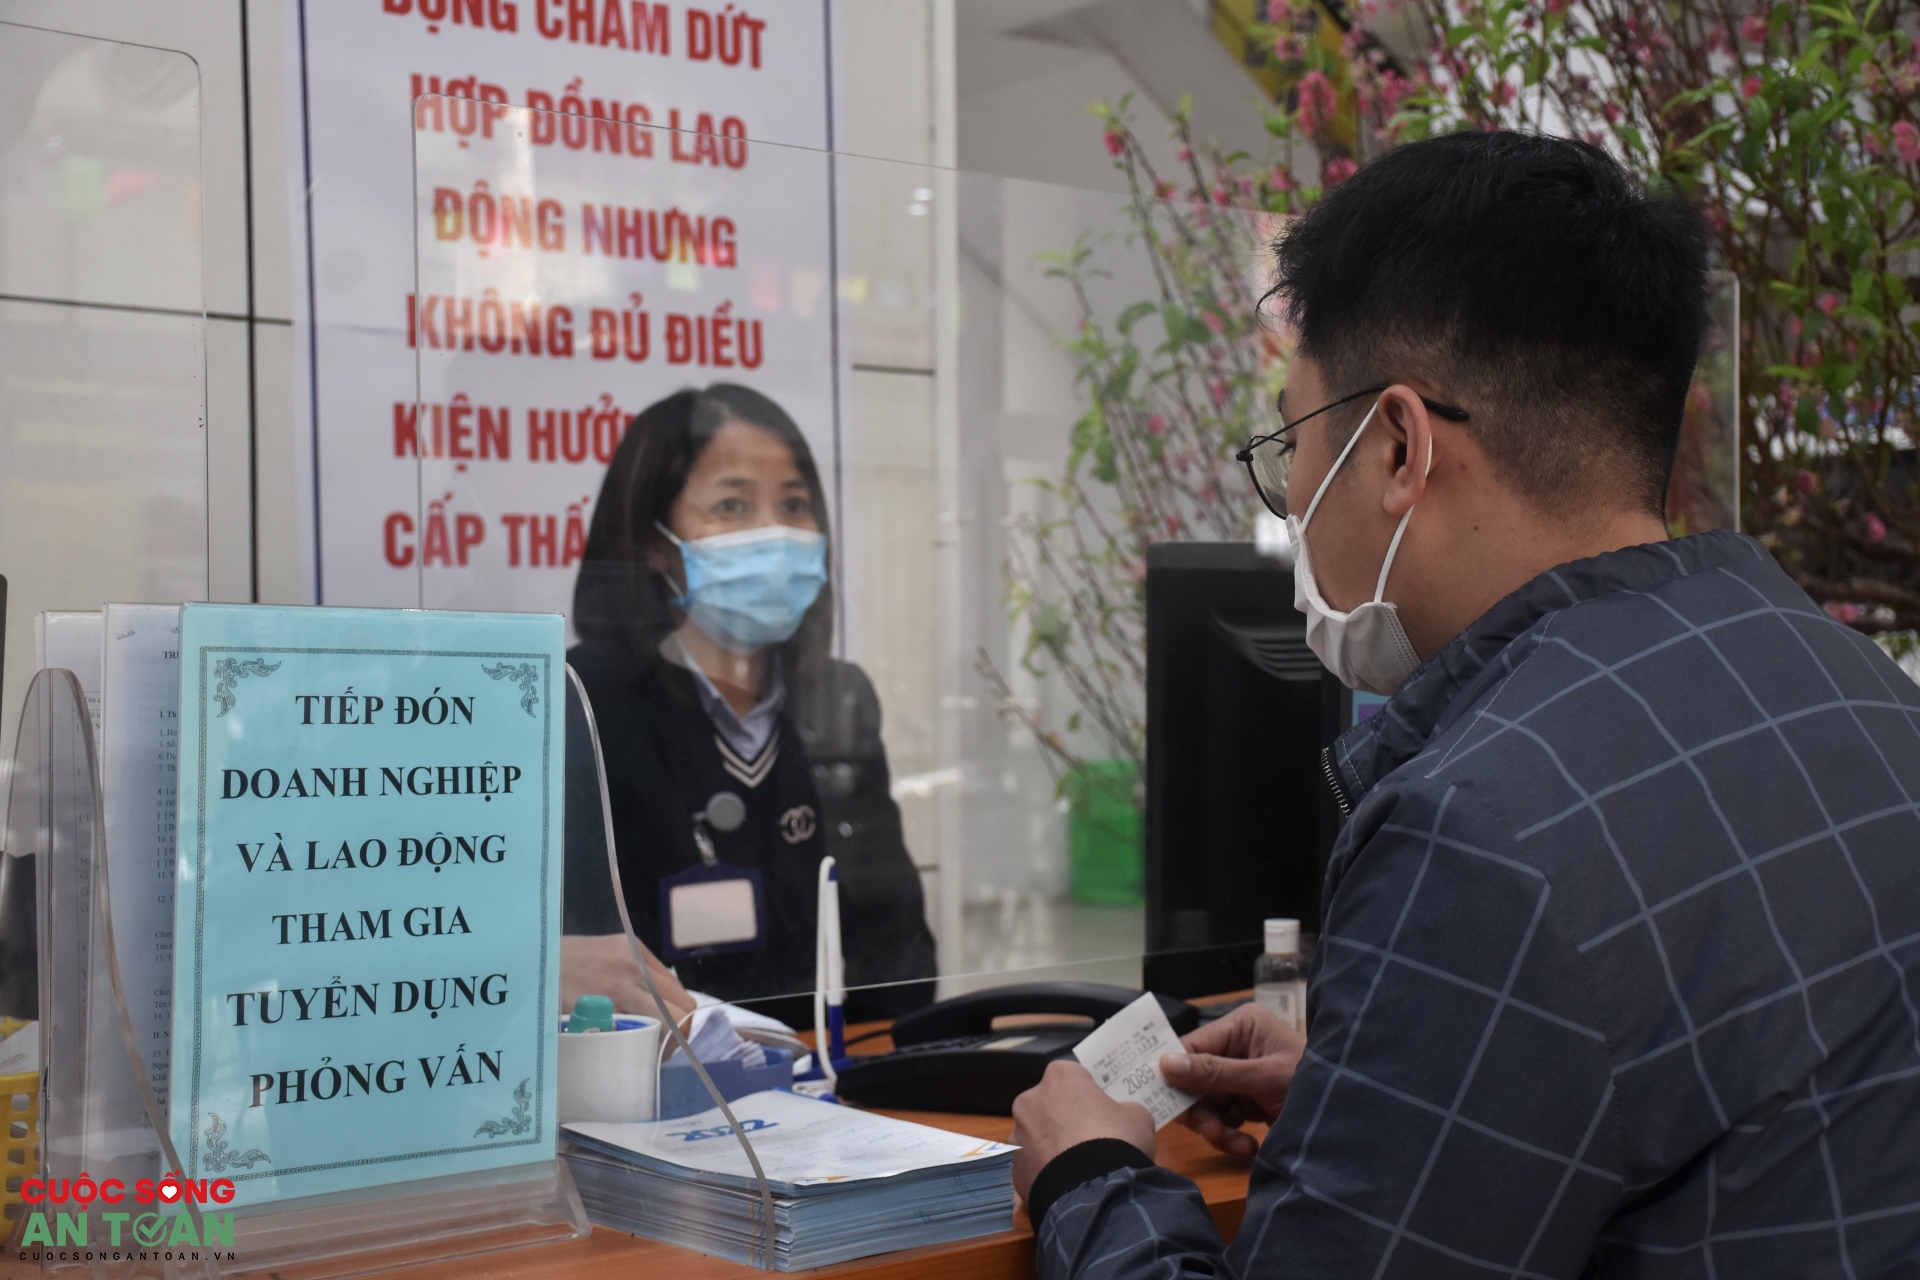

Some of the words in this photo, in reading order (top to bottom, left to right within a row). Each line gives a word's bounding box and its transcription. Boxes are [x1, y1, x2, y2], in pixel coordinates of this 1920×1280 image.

[686, 3, 767, 70] DỨT
[410, 73, 509, 148] HỢP
[526, 77, 653, 158] ĐỒNG
[669, 109, 748, 170] LAO
[433, 180, 565, 258] ĐỘNG
[582, 203, 737, 268] NHƯNG
[407, 287, 574, 358] KHÔNG
[589, 292, 650, 363] ĐỦ
[664, 297, 764, 370] ĐIỀU
[393, 392, 511, 473] KIỆN
[527, 393, 637, 465] HƯỞ
[384, 492, 485, 568] CẤP
[295, 688, 383, 725] TIẾP
[394, 689, 475, 725] ĐÓN
[222, 767, 367, 799] DOANH
[379, 761, 522, 801] NGHIỆP
[236, 832, 294, 873] VÀ
[305, 838, 387, 870] LAO
[397, 832, 506, 873] ĐỘNG
[272, 909, 391, 945] THAM
[403, 905, 471, 936] GIA
[227, 974, 378, 1027] TUYỂN
[393, 974, 508, 1019] DỤNG
[249, 1057, 406, 1107] PHỎNG
[423, 1044, 502, 1088] VẤN
[1122, 1062, 1156, 1096] 2089
